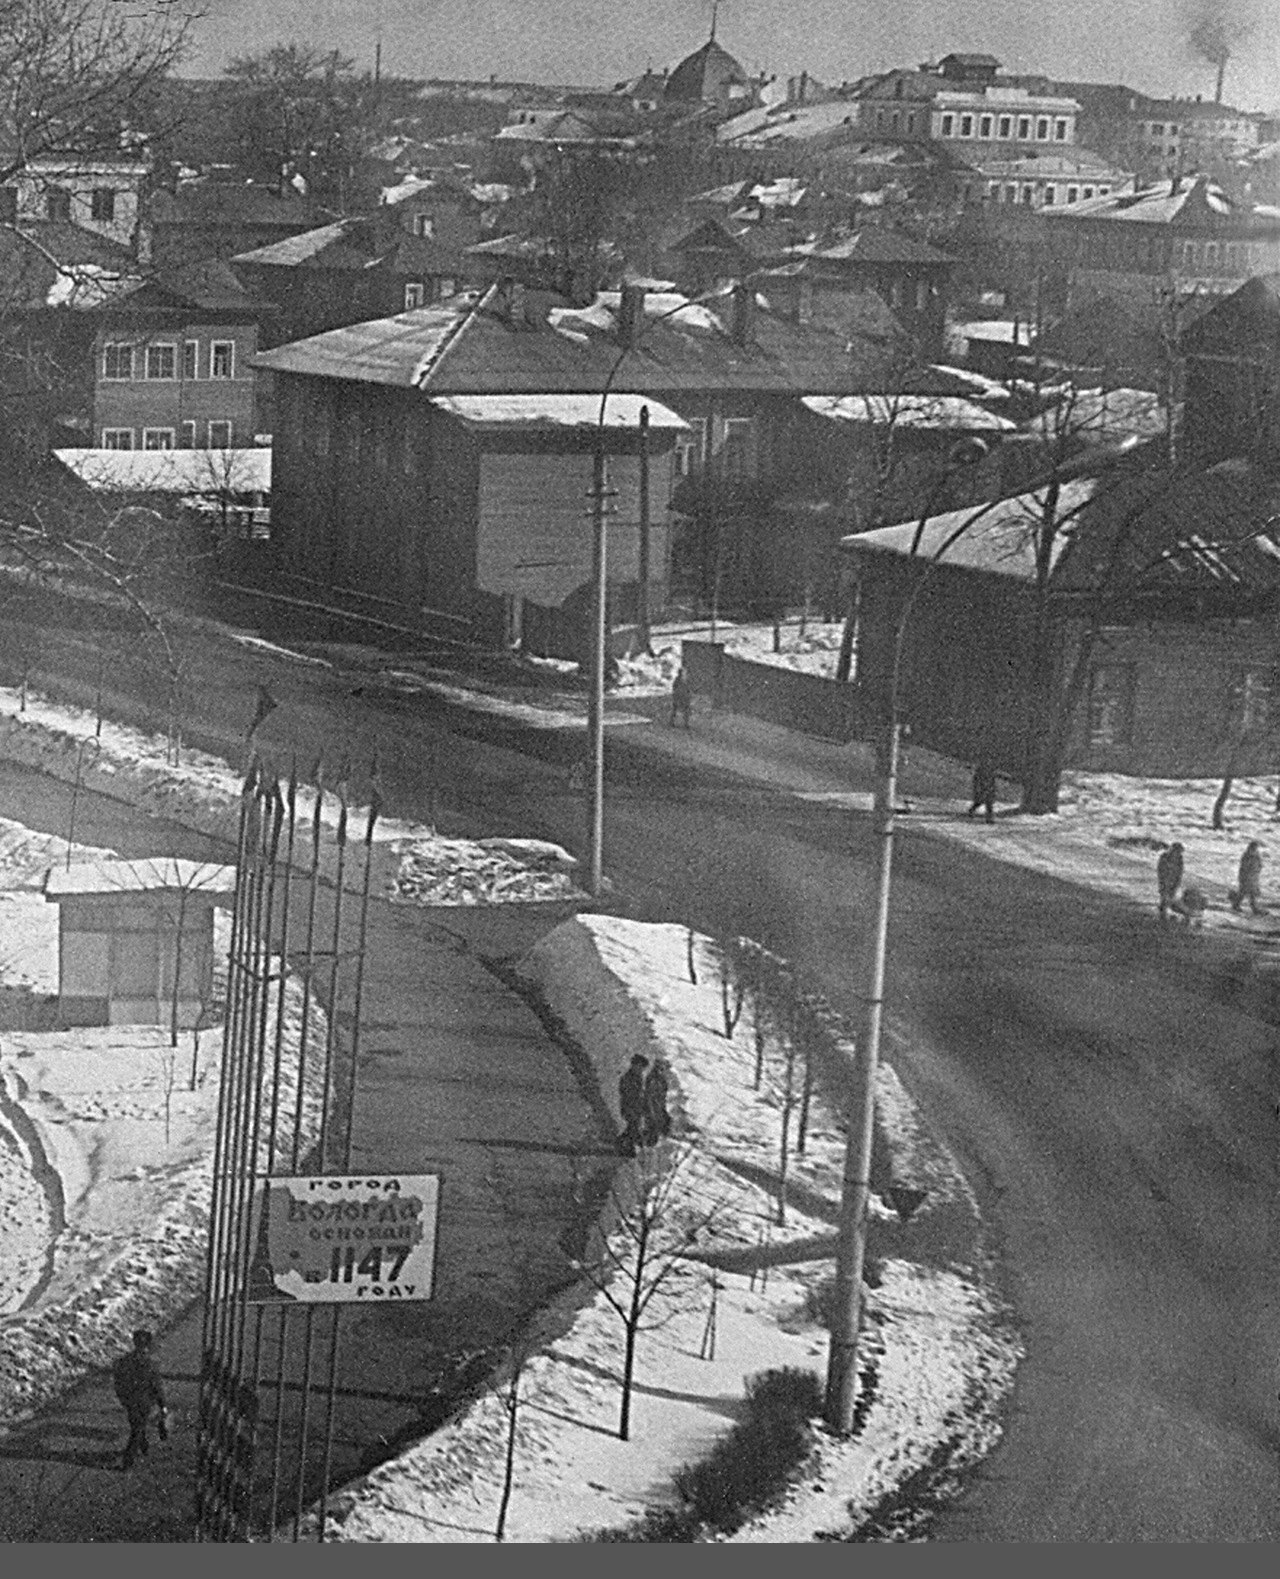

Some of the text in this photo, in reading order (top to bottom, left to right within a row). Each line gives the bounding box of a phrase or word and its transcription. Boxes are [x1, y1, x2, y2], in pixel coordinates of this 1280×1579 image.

[309, 1179, 401, 1192] ГОРОД
[329, 1247, 414, 1283] 1147
[356, 1284, 416, 1297] ГОДУ
